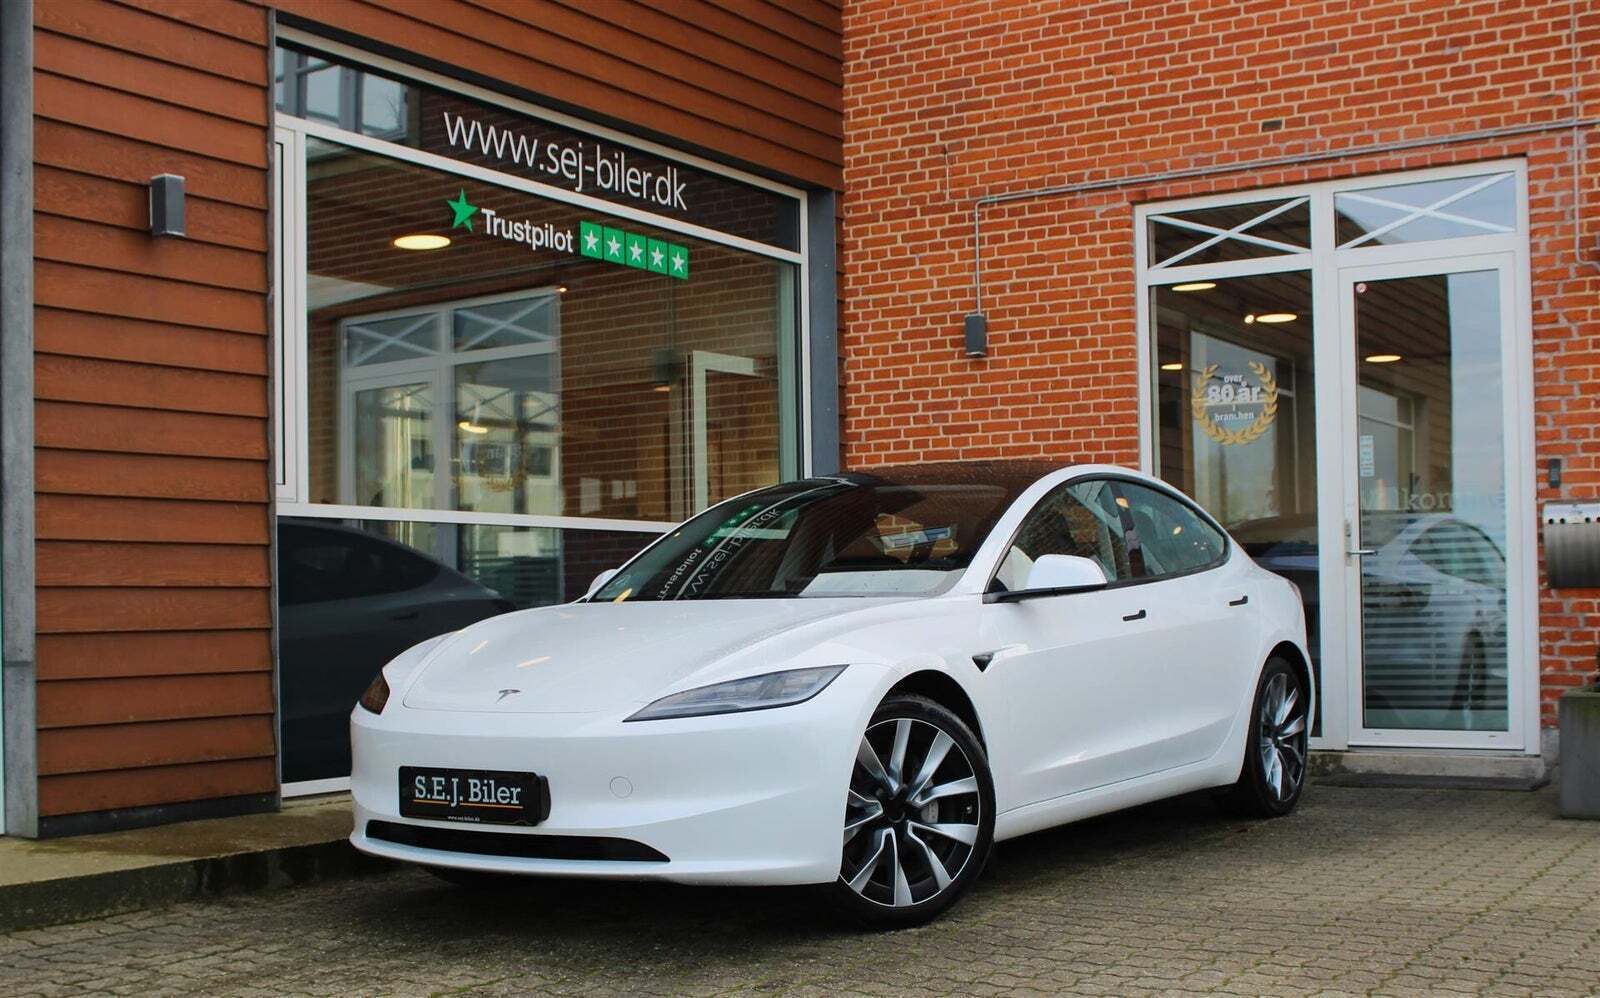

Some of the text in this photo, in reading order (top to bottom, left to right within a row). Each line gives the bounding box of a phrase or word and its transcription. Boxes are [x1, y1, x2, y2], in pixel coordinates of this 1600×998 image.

[444, 111, 688, 211] www.sej-biler.dk
[481, 207, 574, 253] Trustpilot
[1207, 381, 1262, 402] 80 år
[1224, 374, 1243, 383] over
[415, 775, 521, 808] S.E.J. Biler
